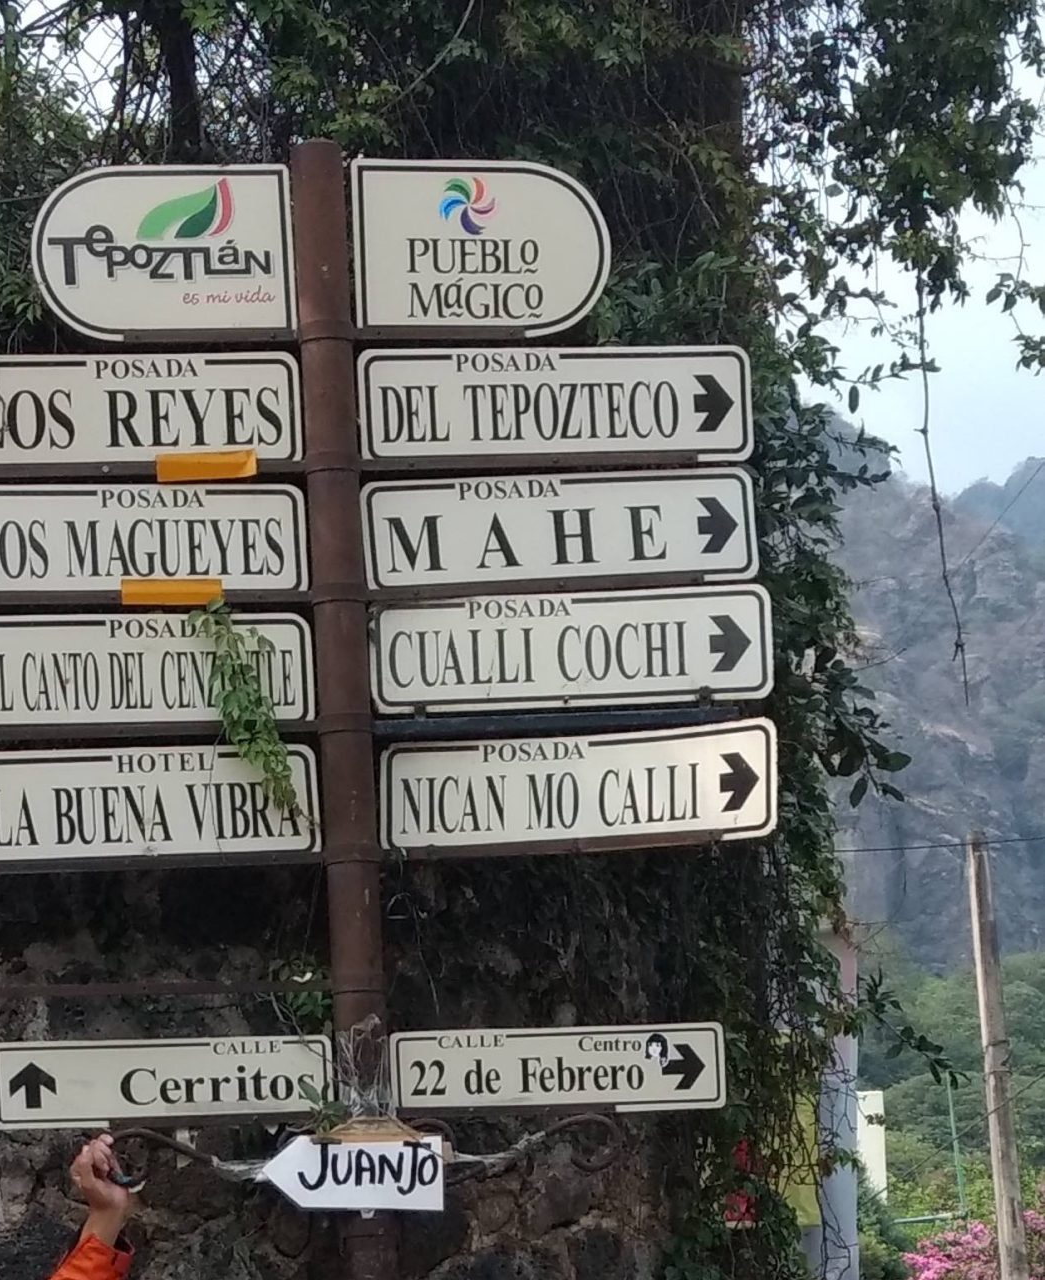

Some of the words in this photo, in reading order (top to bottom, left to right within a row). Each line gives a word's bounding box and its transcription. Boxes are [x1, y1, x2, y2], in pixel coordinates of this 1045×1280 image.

[182, 294, 202, 305] es
[205, 291, 232, 306] mi
[235, 287, 275, 305] vida
[93, 358, 198, 379] POSADA
[455, 353, 558, 372] POSADA
[105, 386, 283, 448] REYES
[379, 385, 450, 443] DEL
[463, 381, 679, 440] TEPOZTECO
[100, 488, 205, 508] POSADA
[458, 480, 560, 500] POSADA
[65, 517, 285, 578] MAGUEYES
[469, 599, 571, 619] POSADA
[389, 628, 535, 688] CUALLI
[557, 621, 690, 681] COCHI
[22, 652, 100, 711] CANTO
[108, 651, 154, 710] DEL
[161, 649, 296, 708] CENZTLE
[482, 741, 586, 762] POSADA
[117, 752, 214, 774] HOTEL
[400, 775, 507, 835] NICAN
[526, 771, 581, 830] MO
[599, 763, 700, 827] CALLI
[52, 785, 174, 845] BUENA
[186, 783, 304, 839] VIBRA
[212, 1040, 281, 1055] CALLE
[438, 1034, 505, 1048] CALLE
[578, 1035, 642, 1052] Centro
[120, 1064, 317, 1102] Cerritos
[410, 1059, 447, 1096] 22
[464, 1058, 501, 1094] de
[518, 1056, 645, 1093] Febrero
